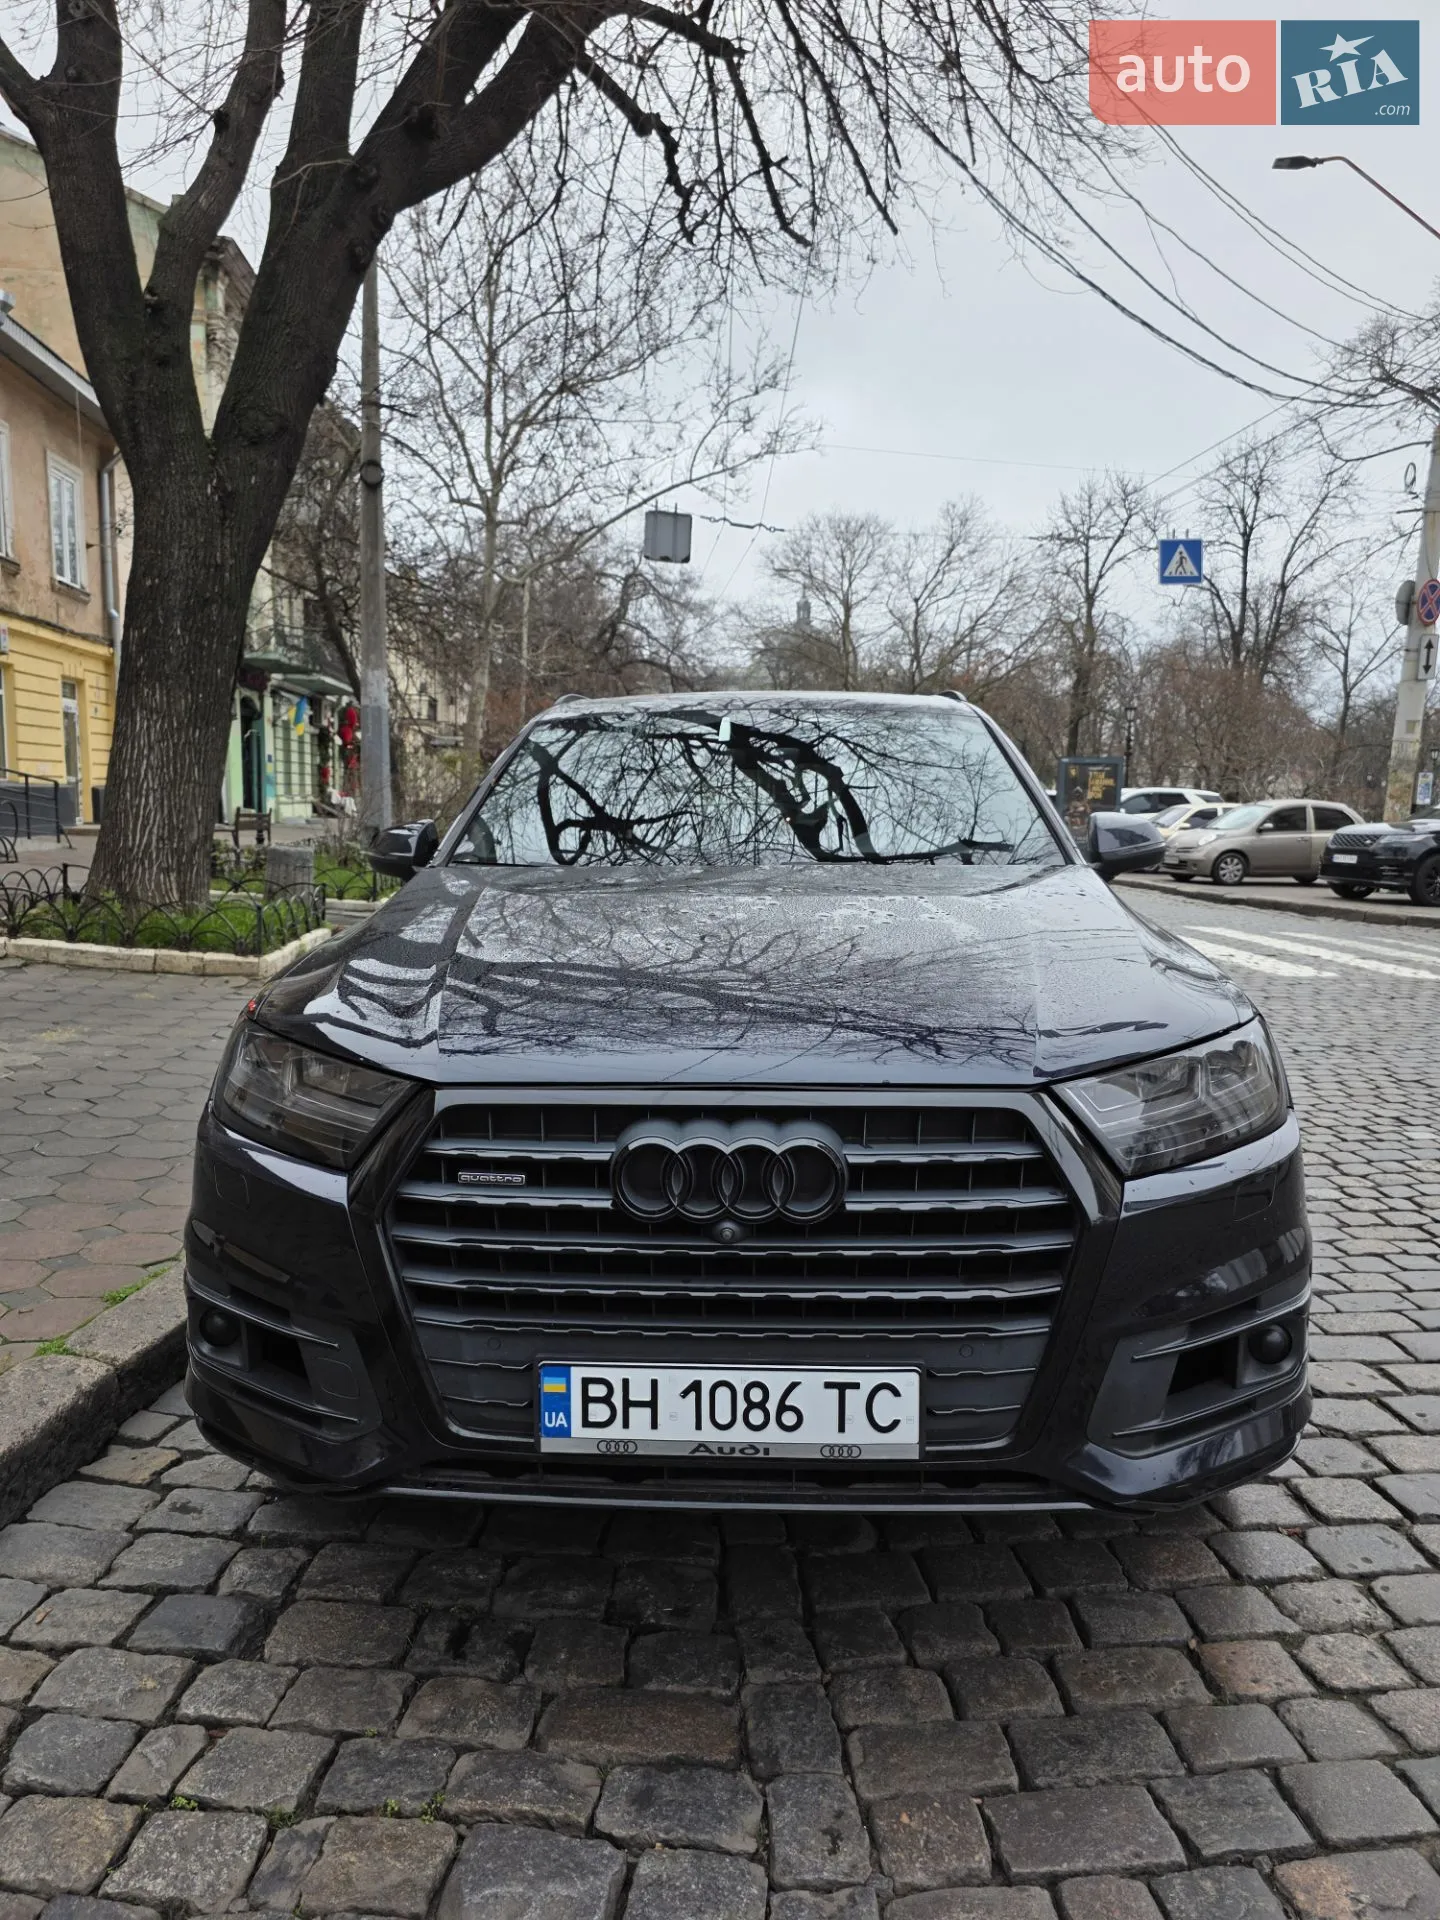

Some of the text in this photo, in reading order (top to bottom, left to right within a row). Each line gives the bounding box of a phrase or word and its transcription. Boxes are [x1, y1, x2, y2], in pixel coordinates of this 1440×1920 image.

[460, 1174, 522, 1183] quattro
[580, 1376, 902, 1434] BH 1086 TC
[544, 1412, 568, 1428] UA
[687, 1442, 770, 1457] Audi
